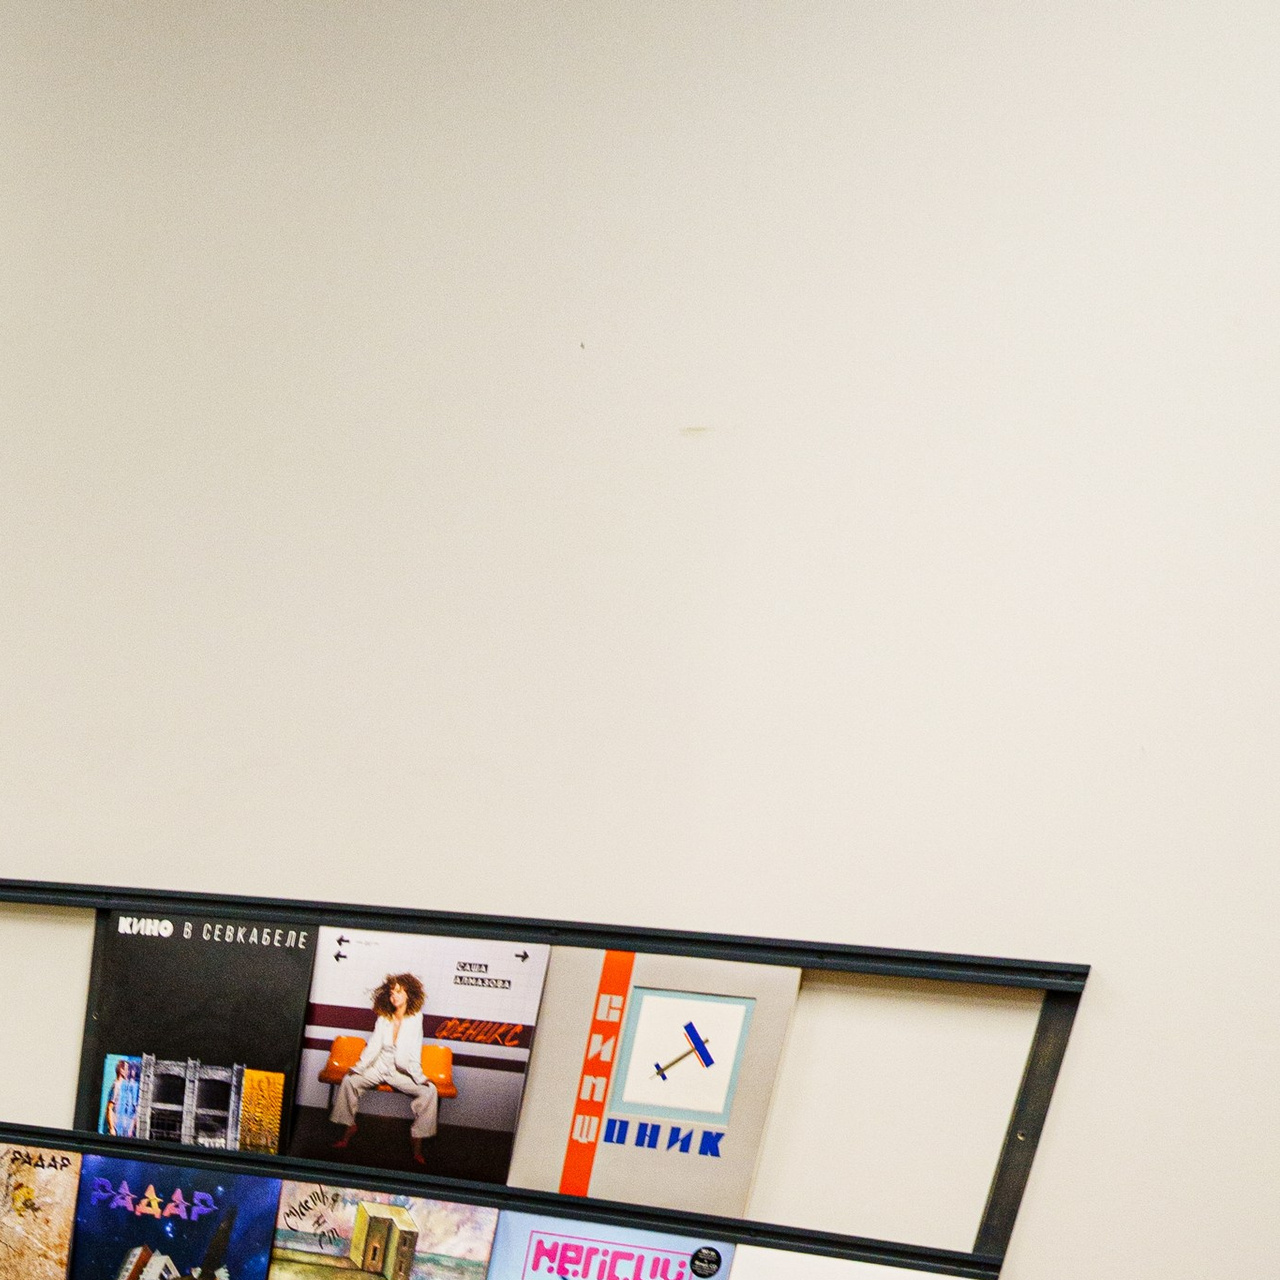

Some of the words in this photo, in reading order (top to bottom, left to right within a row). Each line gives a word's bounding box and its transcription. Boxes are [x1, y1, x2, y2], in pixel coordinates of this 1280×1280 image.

[117, 916, 174, 938] КИНО
[182, 922, 193, 939] В
[202, 923, 309, 949] СЕВКАБЕЛЕ
